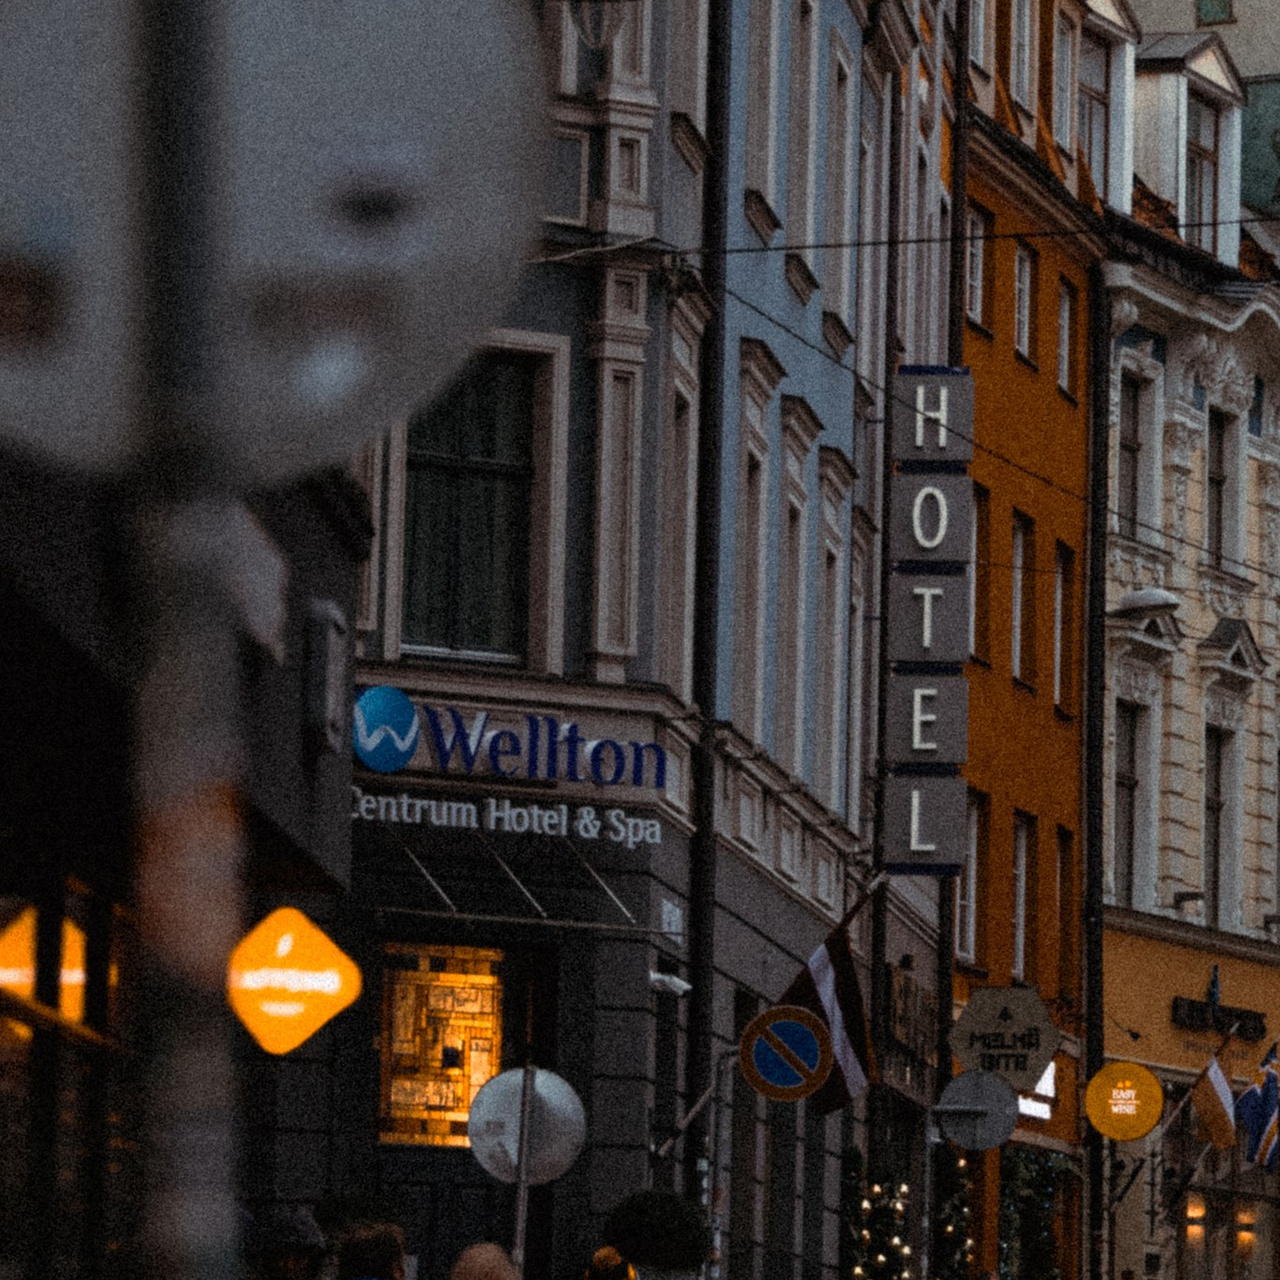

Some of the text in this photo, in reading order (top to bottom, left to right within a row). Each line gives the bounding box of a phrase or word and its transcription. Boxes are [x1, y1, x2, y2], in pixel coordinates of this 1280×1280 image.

[909, 384, 949, 853] HOTEL
[423, 705, 667, 790] Wellton
[488, 798, 568, 837] Hotel
[577, 806, 601, 839] &
[610, 809, 662, 850] Spa
[1111, 1104, 1137, 1114] WINE
[1112, 1088, 1137, 1100] EASY
